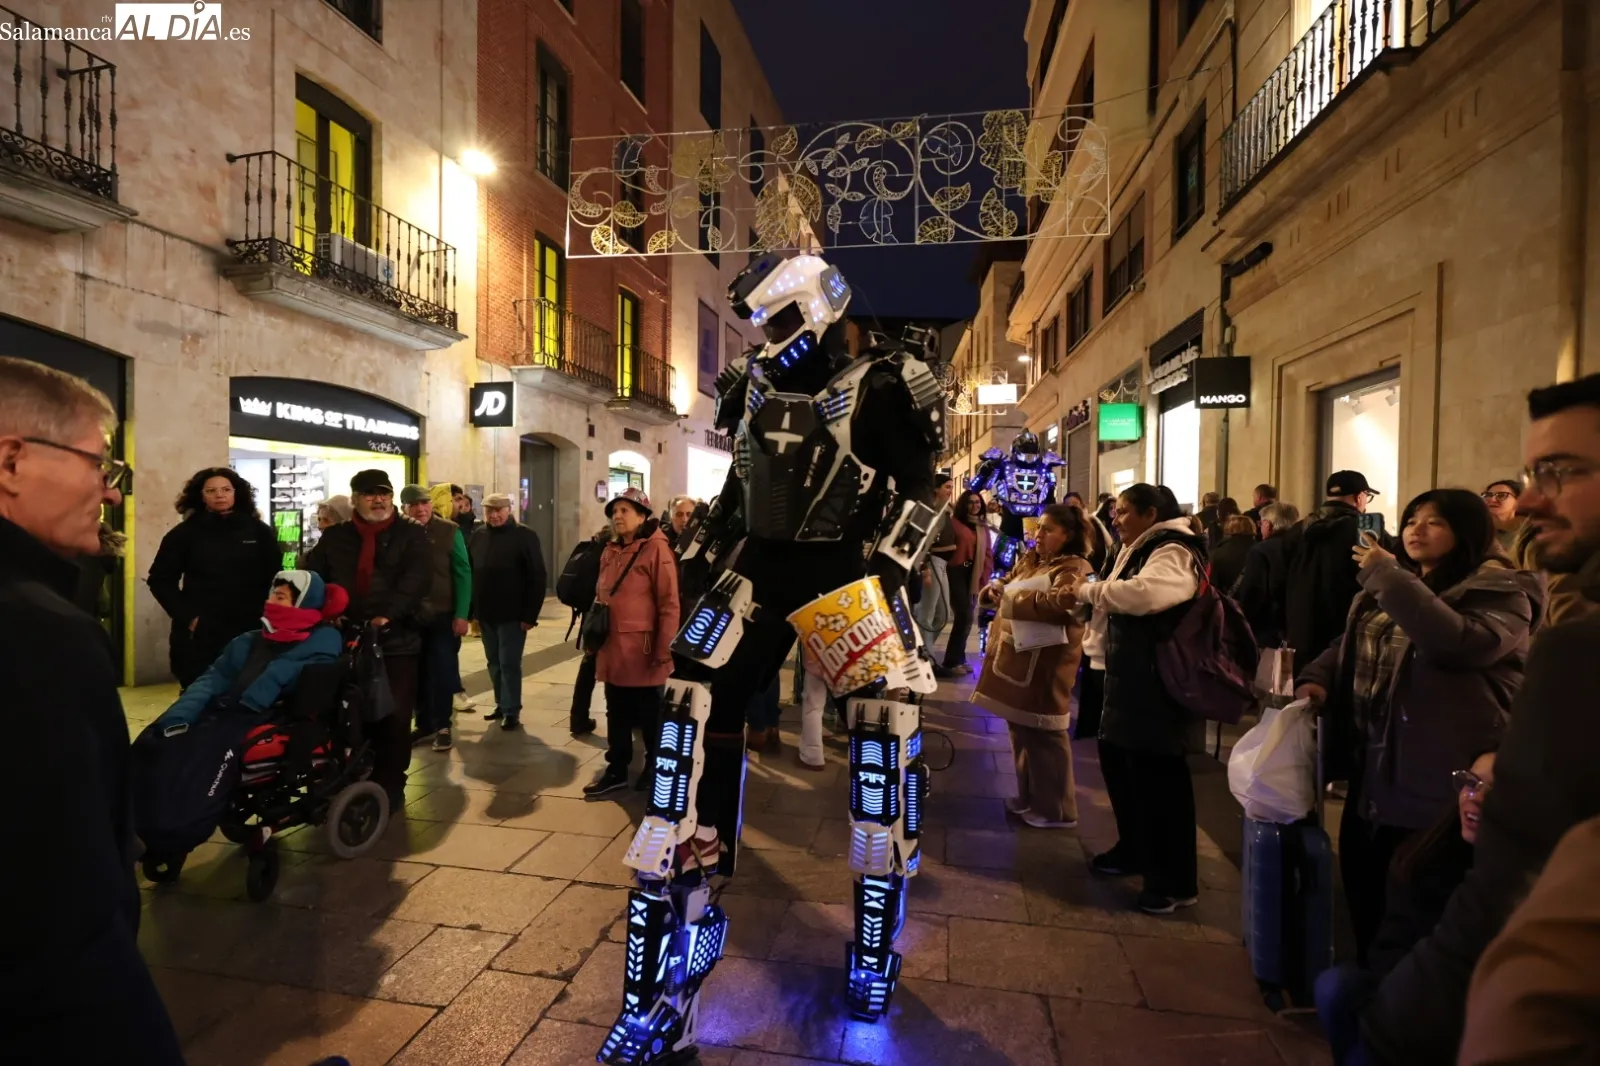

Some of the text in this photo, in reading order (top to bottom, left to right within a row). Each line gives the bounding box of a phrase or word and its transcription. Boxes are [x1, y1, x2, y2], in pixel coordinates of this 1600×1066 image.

[474, 390, 507, 418] JD
[1199, 393, 1247, 405] MANGO
[276, 402, 325, 425] KING
[324, 410, 344, 428] OF
